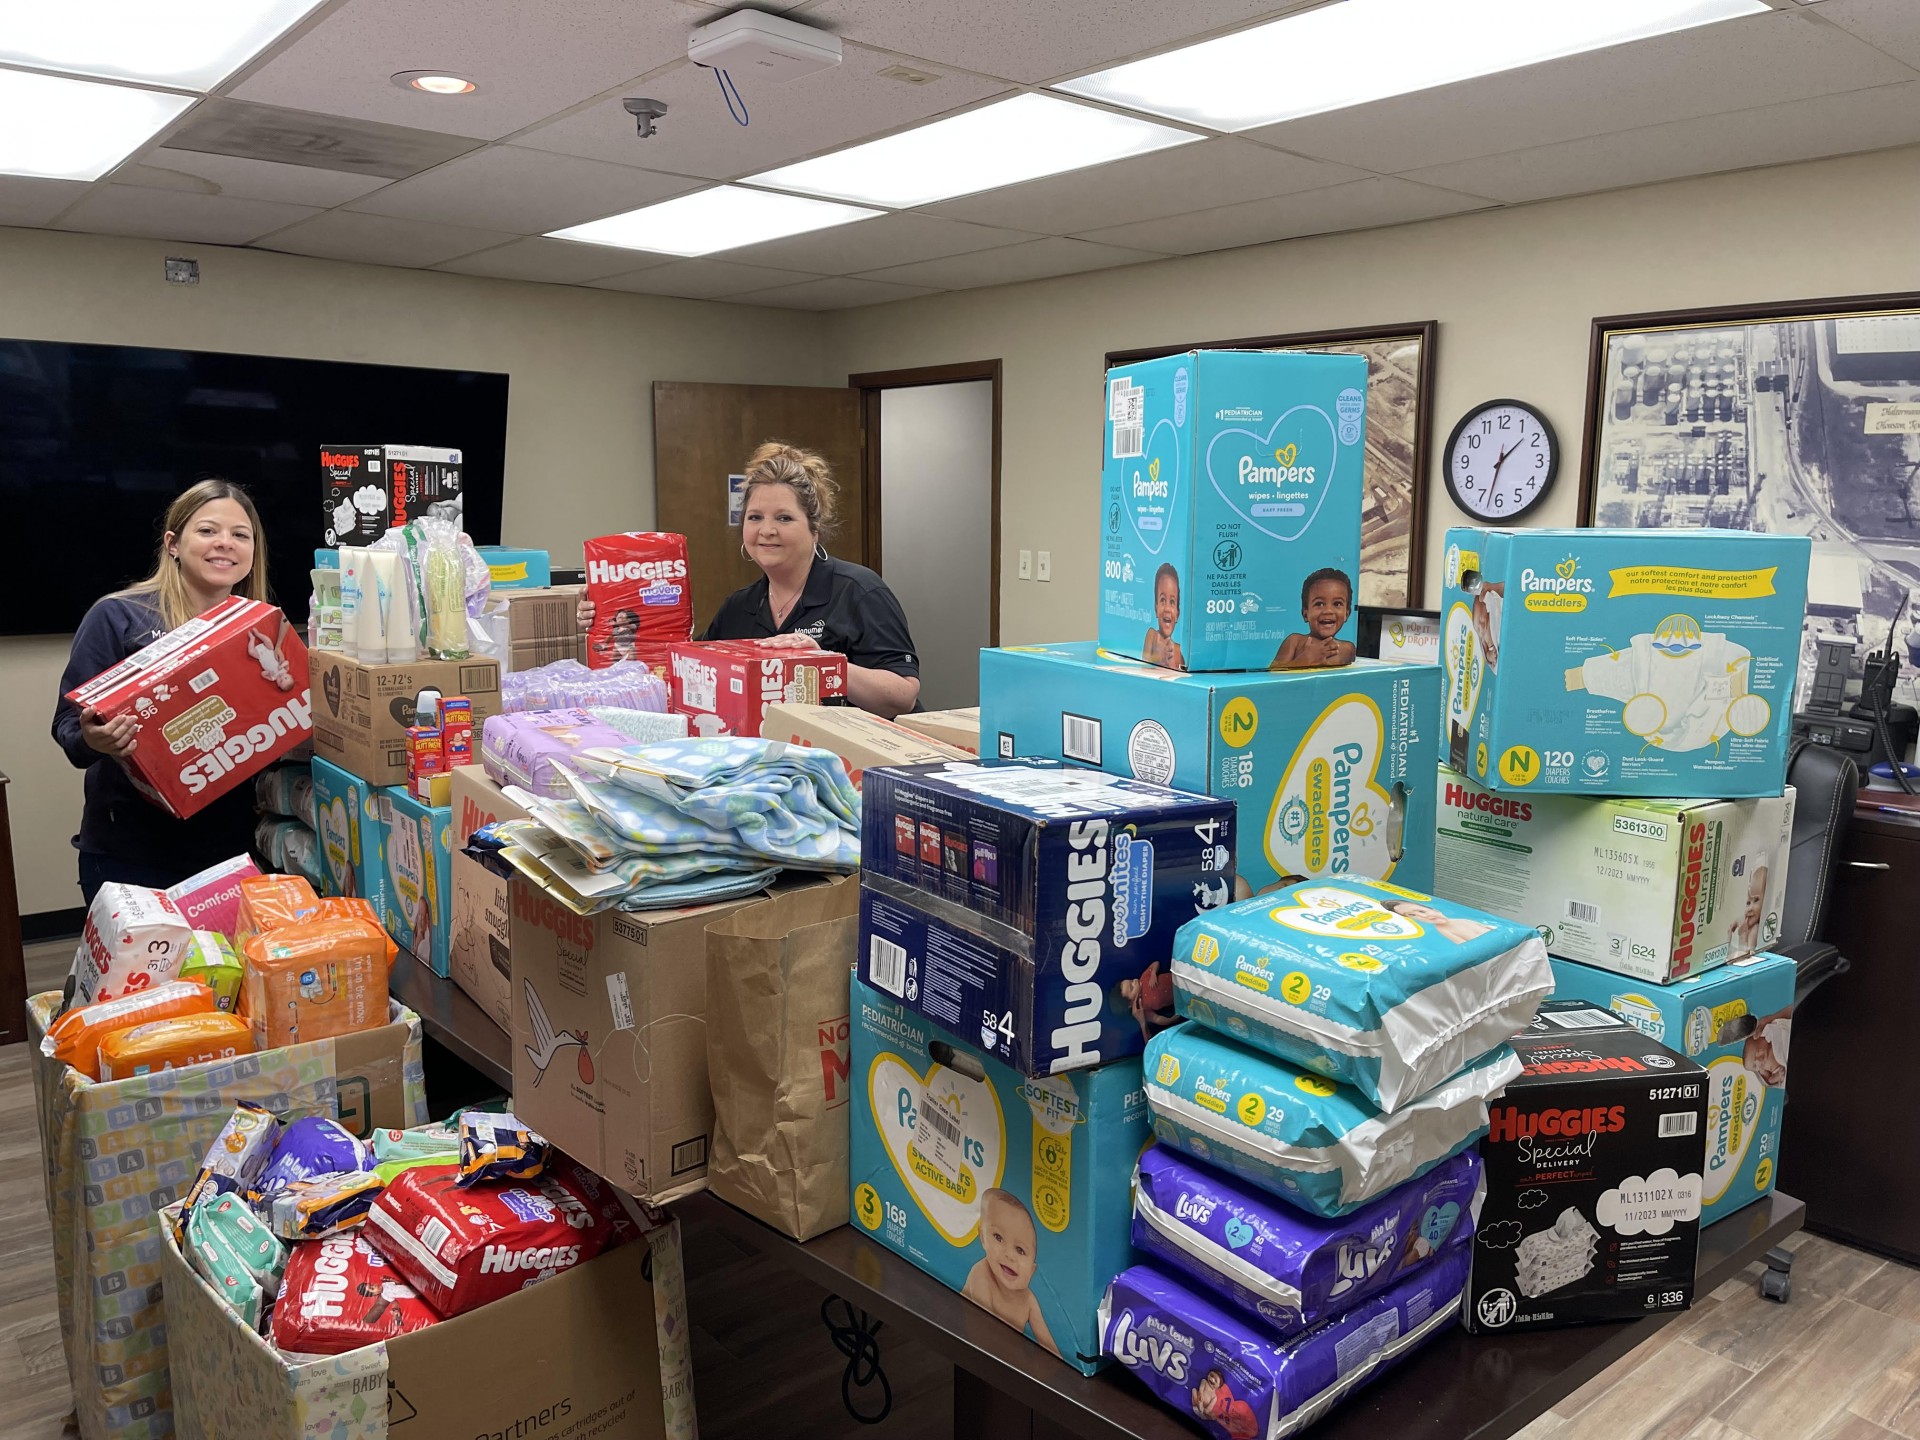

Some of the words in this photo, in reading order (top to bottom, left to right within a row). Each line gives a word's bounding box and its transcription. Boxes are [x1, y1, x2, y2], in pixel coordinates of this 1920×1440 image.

[1482, 420, 1492, 434] 11
[1498, 415, 1511, 429] 12
[1520, 419, 1524, 433] 1
[1467, 434, 1481, 449] 10
[1531, 433, 1540, 448] 2
[321, 451, 359, 468] HUGGIES
[1461, 455, 1470, 469] 9
[1535, 453, 1544, 469] 3
[1239, 455, 1315, 488] Pampers
[1465, 475, 1474, 490] 8
[1526, 475, 1536, 490] 4
[1133, 470, 1168, 502] Pampers
[1249, 492, 1270, 501] wipes
[1276, 491, 1309, 501] lingettes
[1478, 489, 1487, 503] 7
[1514, 488, 1523, 503] 5
[1494, 493, 1504, 508] 6
[589, 559, 687, 584] HUGGIES
[1105, 560, 1121, 579] 800
[1669, 570, 1700, 580] comfort
[1717, 573, 1757, 581] protection
[639, 585, 682, 596] movers
[1520, 568, 1593, 596] Pampers
[1651, 577, 1690, 587] protection
[1678, 585, 1693, 593] plus
[1206, 599, 1235, 614] 800
[1527, 597, 1583, 608] swaddlers
[670, 651, 718, 686] HUGGIES
[1453, 624, 1467, 715] Pampers
[376, 674, 413, 687] 12-72's
[826, 676, 833, 689] 96
[140, 704, 159, 720] 96
[1233, 712, 1254, 733] 2
[172, 709, 235, 753] snugglers
[1398, 679, 1410, 778] PEDIATRICIAN
[179, 688, 313, 794] HUGGIES
[416, 742, 428, 750] BUTT
[1238, 751, 1254, 788] 186
[1509, 750, 1531, 773] N
[1543, 751, 1575, 767] 120
[1221, 757, 1230, 789] COUCHES
[1230, 757, 1238, 787] DIAPERS
[1544, 776, 1570, 785] COUCHES
[1545, 768, 1571, 776] DIAPERS
[1328, 742, 1363, 874] Pampers
[1445, 782, 1533, 822] HUGGIES
[1289, 810, 1300, 829] #1
[1311, 763, 1323, 867] swaddlers
[1457, 810, 1493, 824] natural
[1494, 819, 1518, 829] care
[325, 820, 346, 850] Pampers
[1195, 817, 1220, 845] 4
[1141, 845, 1149, 880] DIAPER
[1201, 846, 1214, 872] 58
[1596, 865, 1623, 880] 12/2023
[1111, 834, 1131, 947] overnites
[1671, 822, 1705, 979] HUGGIES
[1696, 868, 1710, 936] natural
[512, 881, 594, 951] HUGGIES
[1301, 901, 1374, 926] Pampers
[614, 921, 635, 939] 53775
[85, 911, 113, 975] HUGGIES
[149, 940, 170, 955] 3
[1049, 818, 1111, 1074] HUGGIES
[1196, 940, 1205, 958] OPEN
[1612, 939, 1619, 950] 3
[1632, 944, 1656, 959] 624
[1235, 954, 1275, 982] Pampers
[356, 985, 366, 999] the
[1236, 974, 1268, 990] swaddlers
[1288, 975, 1304, 995] 2
[1312, 985, 1331, 1001] 29
[356, 1000, 365, 1024] move
[862, 1004, 924, 1044] PEDIATRICIAN
[982, 1009, 997, 1030] 58
[998, 1010, 1015, 1046] 4
[1522, 1056, 1648, 1076] HUGGIES
[1026, 1083, 1078, 1117] SOFTEST
[1194, 1075, 1232, 1103] Pampers
[1046, 1106, 1061, 1120] FIT
[1196, 1094, 1225, 1111] swaddlers
[1245, 1097, 1259, 1116] 2
[1267, 1106, 1285, 1123] 29
[1489, 1105, 1626, 1143] HUGGIES
[1709, 1074, 1733, 1172] Pampers
[1732, 1078, 1743, 1151] swaddlers
[898, 1087, 985, 1168] Pars
[1517, 1129, 1597, 1165] Special
[1759, 1133, 1768, 1159] 120
[1536, 1158, 1580, 1169] DELIVERY
[574, 1166, 599, 1200] movers
[915, 1161, 944, 1186] ACTIVE
[946, 1177, 968, 1198] BABY
[1535, 1171, 1575, 1181] PERFECT
[1756, 1167, 1767, 1184] N
[510, 1188, 555, 1223] movers
[863, 1187, 874, 1215] 3
[885, 1201, 907, 1228] 168
[1620, 1188, 1674, 1205] ML131102X
[1431, 1212, 1438, 1227] 2
[1625, 1209, 1657, 1222] 11/2023
[1255, 1236, 1265, 1245] 40
[1428, 1230, 1439, 1241] 40
[480, 1244, 581, 1275] HUGGIES
[1647, 1295, 1654, 1303] 6
[1661, 1290, 1684, 1304] 336
[1147, 1316, 1167, 1334] pro
[1168, 1325, 1195, 1349] level
[1113, 1312, 1188, 1380] Luvs
[310, 1368, 327, 1378] love
[352, 1372, 385, 1395] BABY
[661, 1378, 686, 1401] BABY
[304, 1422, 320, 1432] love
[561, 1407, 608, 1436] cartridges
[609, 1399, 625, 1412] out
[588, 1410, 627, 1439] recycled
